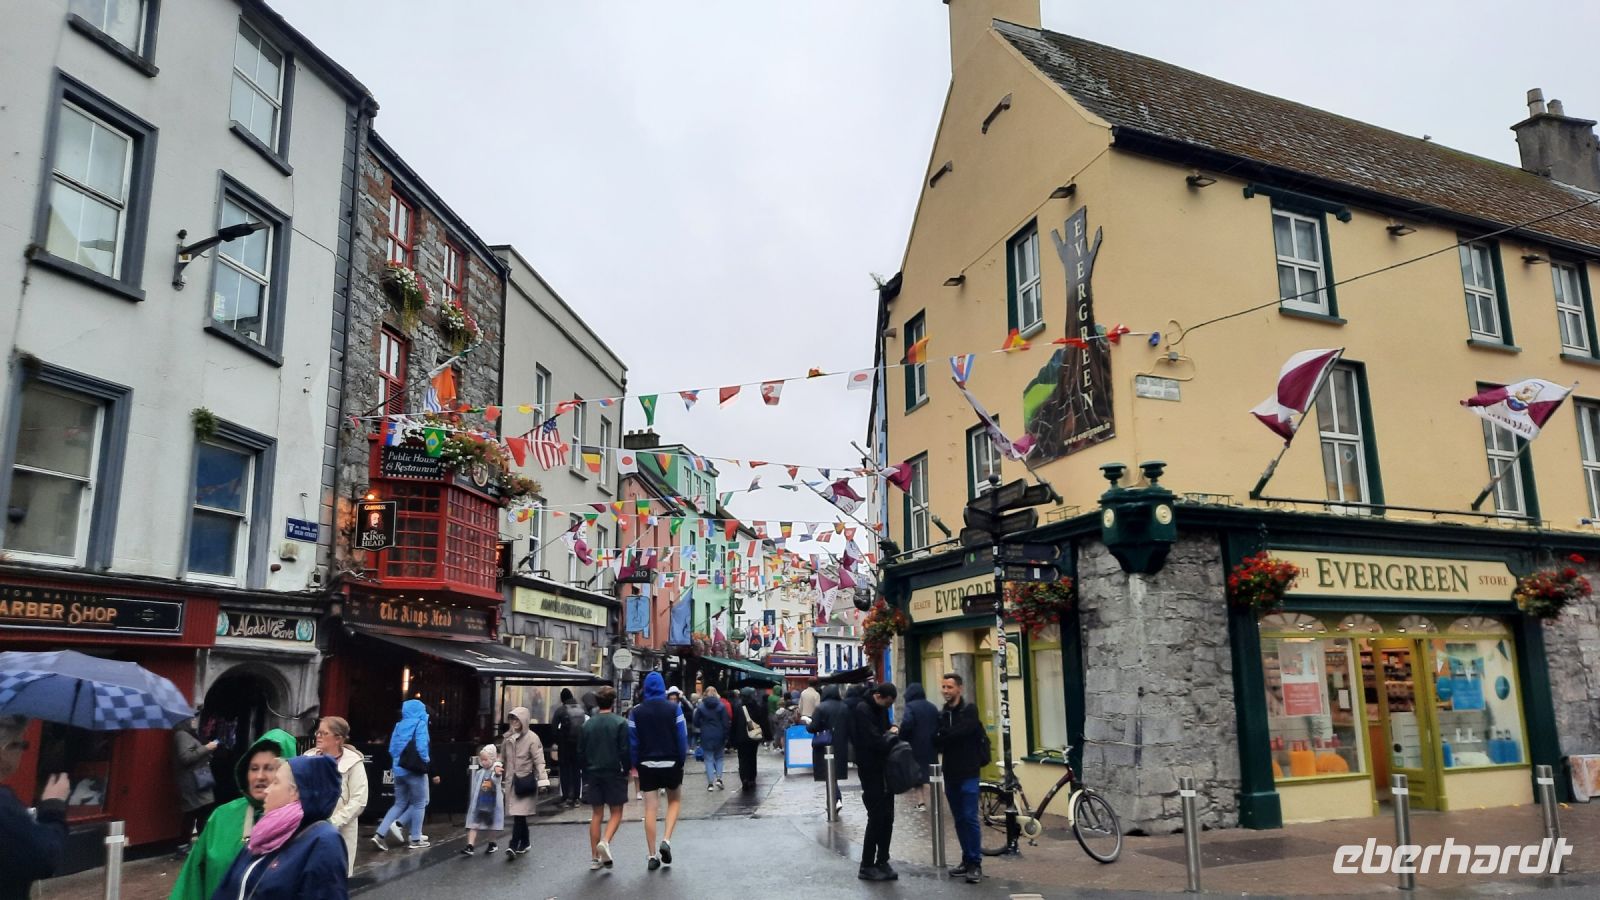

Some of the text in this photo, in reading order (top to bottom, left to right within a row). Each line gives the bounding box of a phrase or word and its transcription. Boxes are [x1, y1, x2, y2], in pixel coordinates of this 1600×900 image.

[1073, 218, 1094, 411] EVERGREEN
[385, 462, 439, 474] & Restaurant
[388, 451, 437, 464] Public House
[1315, 557, 1470, 593] EVERGREEN
[1478, 575, 1509, 587] STORE
[934, 580, 995, 614] EVERGRE
[0, 600, 118, 625] ARBER SHOP
[379, 601, 399, 620] The
[400, 605, 429, 628] Kings
[430, 609, 452, 627] Head
